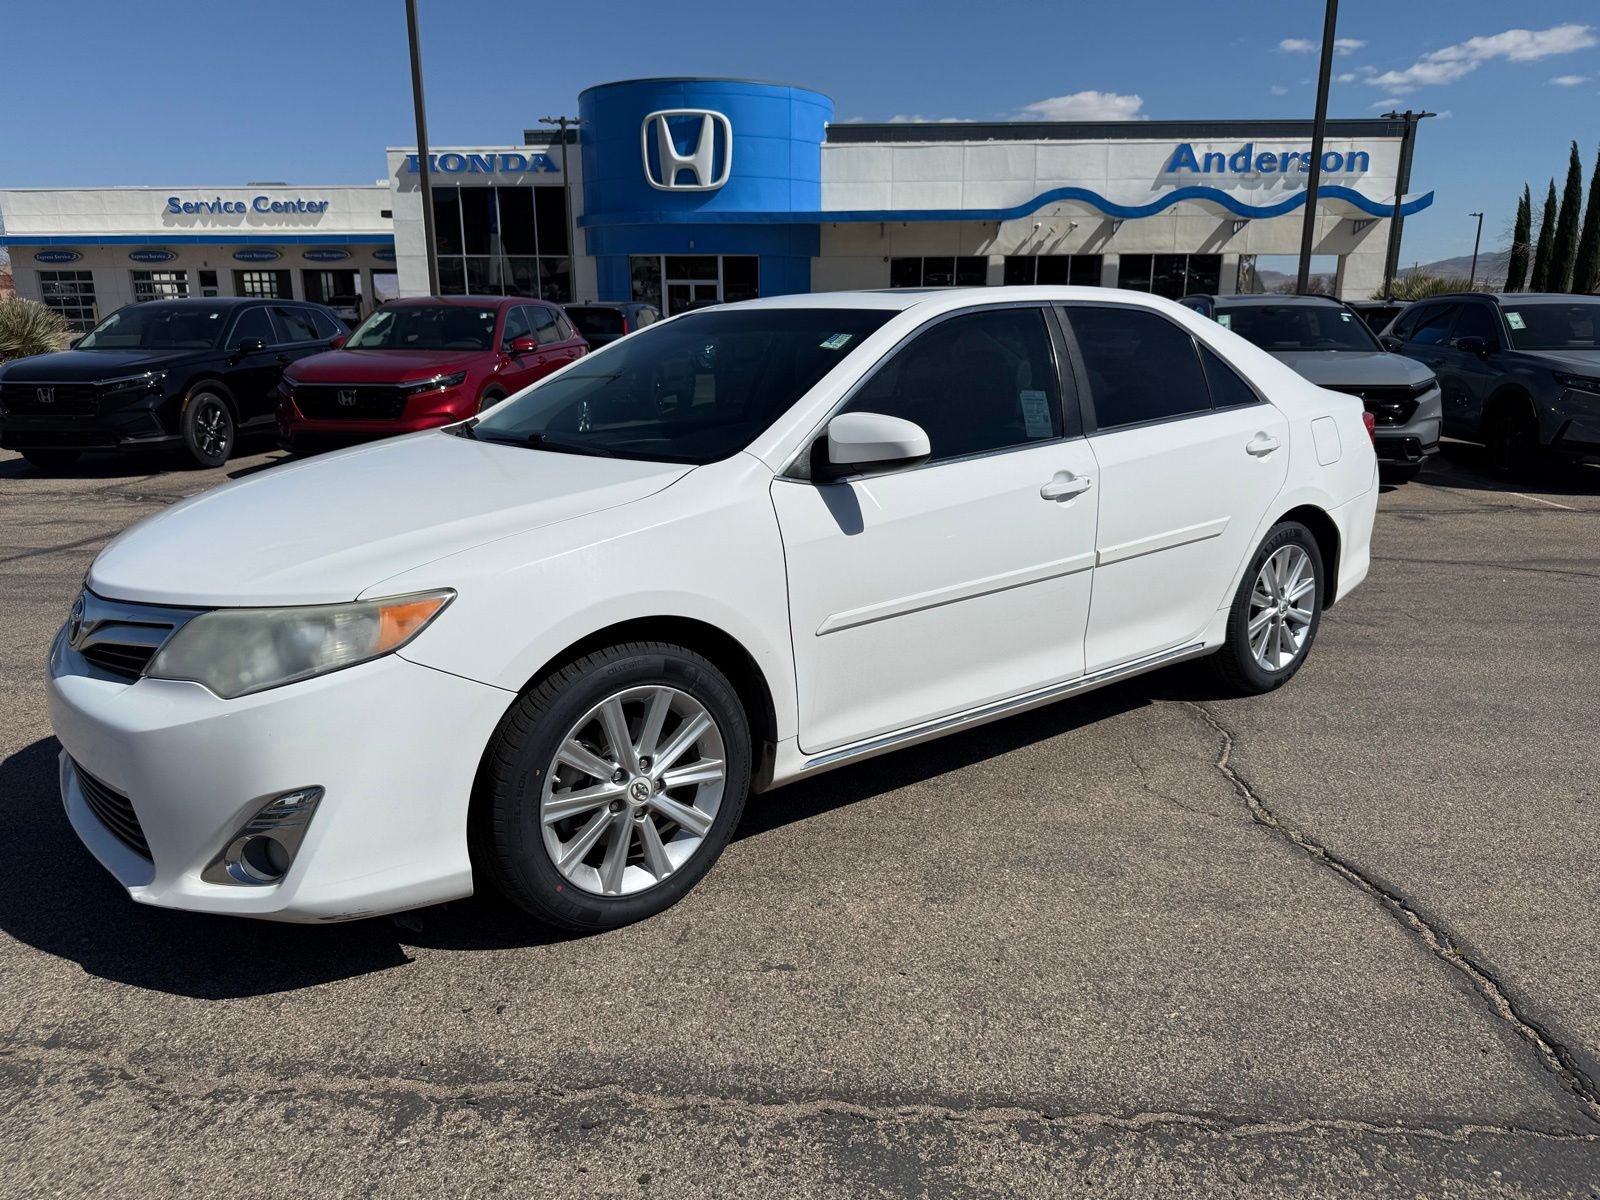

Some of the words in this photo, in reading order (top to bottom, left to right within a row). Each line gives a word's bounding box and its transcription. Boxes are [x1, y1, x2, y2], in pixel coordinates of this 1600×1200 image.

[406, 152, 560, 174] HONDA
[1166, 142, 1370, 174] Anderson
[167, 196, 246, 215] Service
[252, 195, 329, 214] Center
